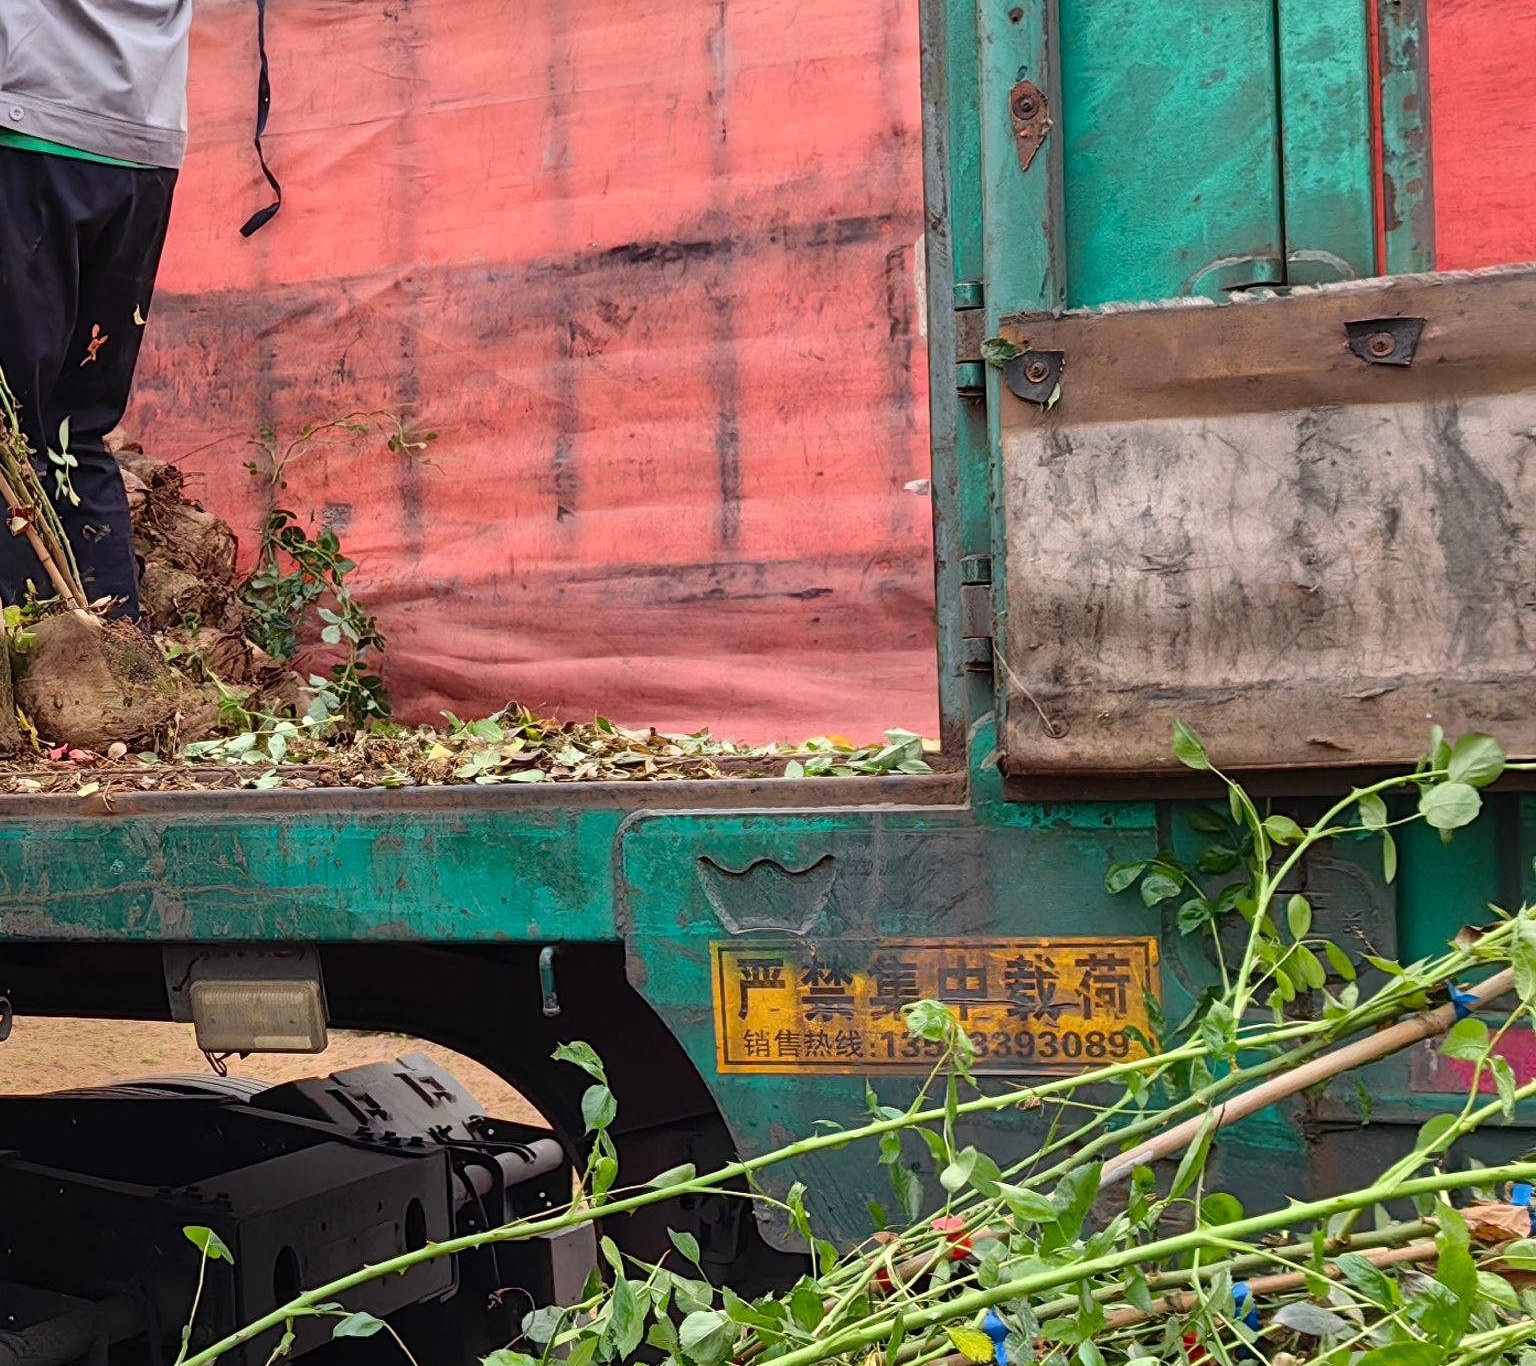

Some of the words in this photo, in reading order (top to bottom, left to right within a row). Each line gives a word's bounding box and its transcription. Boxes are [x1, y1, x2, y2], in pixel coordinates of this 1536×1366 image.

[736, 953, 1131, 1023] 严禁集中载荷
[743, 1029, 1129, 1059] 销售热线:1353393089
